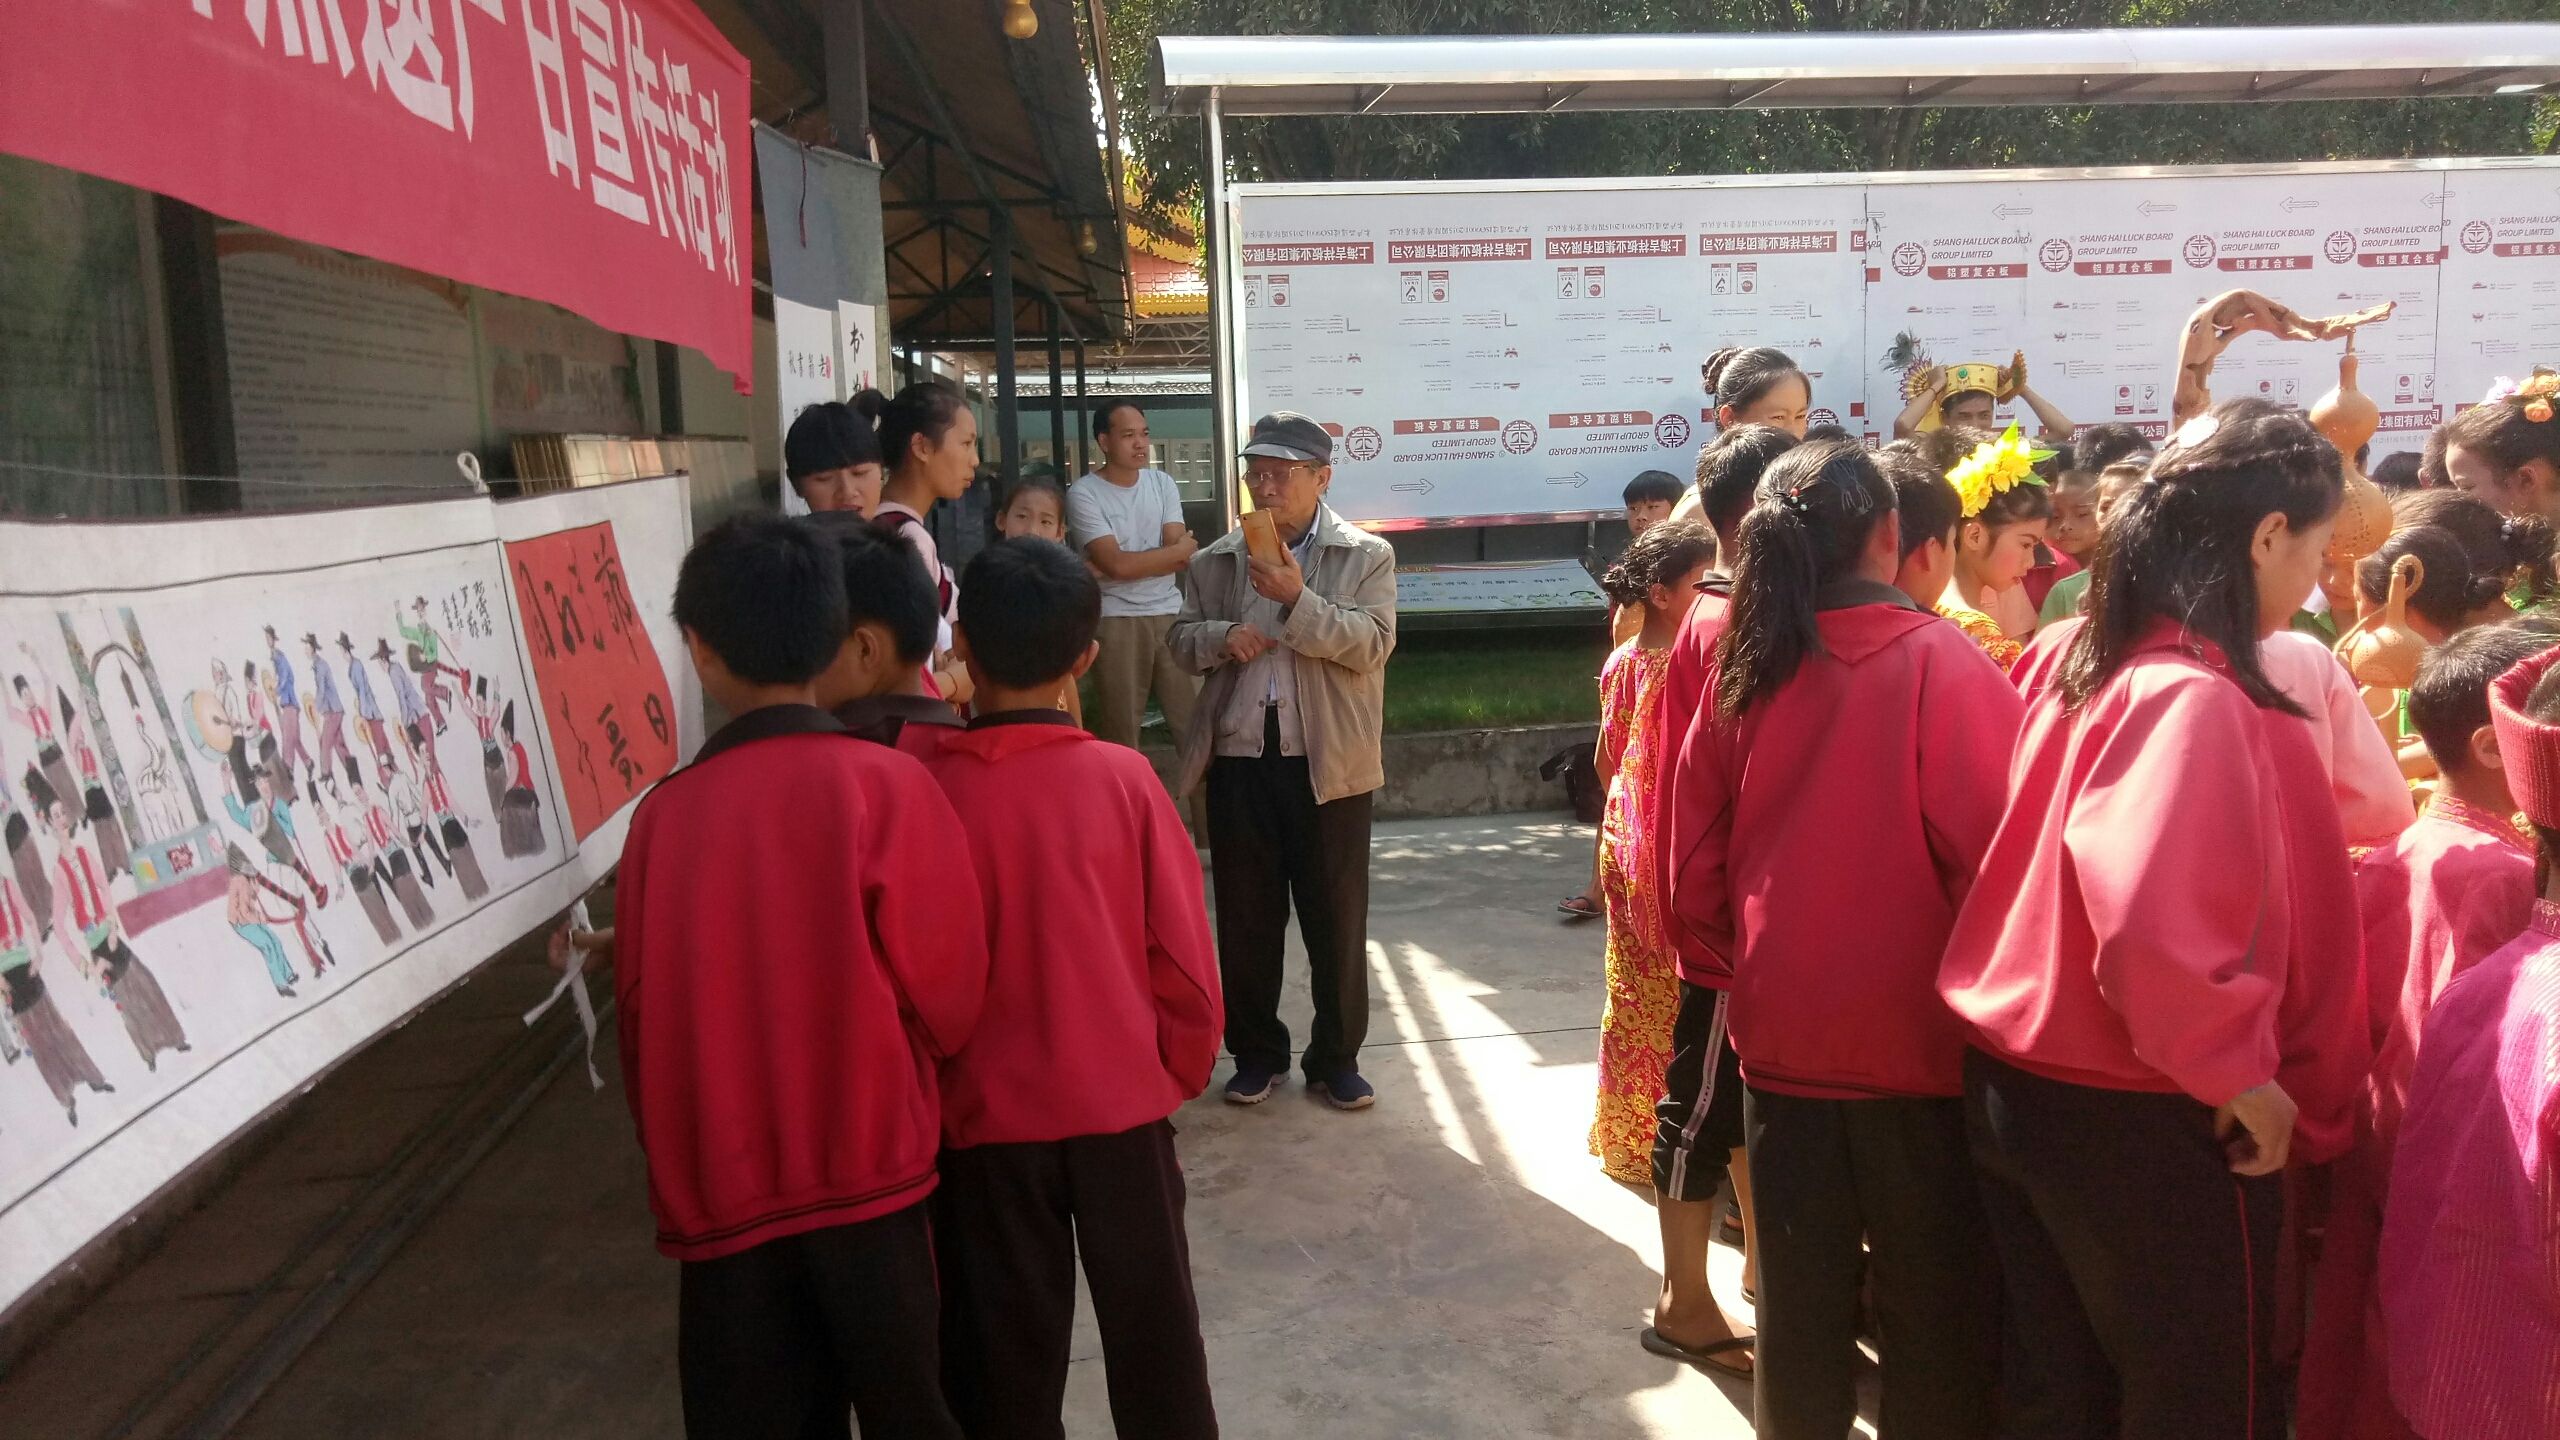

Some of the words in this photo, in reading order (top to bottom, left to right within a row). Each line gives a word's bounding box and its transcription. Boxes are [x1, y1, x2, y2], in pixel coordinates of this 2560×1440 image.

[2499, 216, 2526, 225] SHANG
[2526, 216, 2540, 224] HAI
[2223, 231, 2250, 239] SHANG
[2251, 230, 2266, 238] HAI
[2266, 229, 2287, 238] LUCK
[2288, 228, 2315, 237] BOARD
[2363, 227, 2390, 235] SHANG
[2391, 226, 2406, 234] HAI
[2406, 225, 2427, 233] LUCK
[2497, 229, 2524, 238] GROUP
[2524, 228, 2554, 237] LIMITED
[1702, 234, 1834, 251] 上海吉祥板业集团有限公司
[1933, 238, 1962, 247] SHANG
[1963, 237, 1978, 246] HAI
[1978, 236, 2000, 245] LUCK
[2001, 236, 2031, 245] BOARD
[2080, 234, 2107, 243] SHANG
[2107, 234, 2123, 242] HAI
[2123, 233, 2145, 241] LUCK
[2146, 232, 2174, 241] BOARD
[1548, 238, 1683, 255] 上海吉祥板业集团有限公司
[2221, 243, 2249, 252] GROUP
[2249, 242, 2280, 251] LIMITED
[2361, 239, 2389, 248] GROUP
[2389, 238, 2420, 247] LIMITED
[1391, 242, 1529, 260] 上海吉祥板业集团有限公司
[2077, 247, 2105, 256] GROUP
[2106, 246, 2138, 255] LIMITED
[2510, 243, 2560, 255] 铝塑复合
[1931, 251, 1960, 260] GROUP
[1961, 250, 1993, 259] LIMITED
[2375, 253, 2435, 265] 铝塑复合板
[2092, 262, 2153, 274] 铝塑复合板
[2235, 257, 2295, 270] 铝塑复合板
[1946, 265, 2010, 279] 铝塑复合板
[1568, 412, 1633, 426] 铝塑复合板
[1413, 418, 1480, 433] 铝塑复合板
[1586, 432, 1620, 442] LIMITED
[1619, 431, 1650, 440] GROUP
[1431, 438, 1466, 448] LIMITED
[1466, 437, 1497, 446] GROUP
[1548, 447, 1578, 456] BOARD
[1578, 446, 1602, 455] LUCK
[1601, 445, 1618, 454] HAI
[1618, 444, 1648, 453] SHANG
[1393, 453, 1424, 463] BOARD
[1424, 452, 1448, 462] LUCK
[1448, 451, 1465, 460] HAI
[1465, 450, 1496, 460] SHANG
